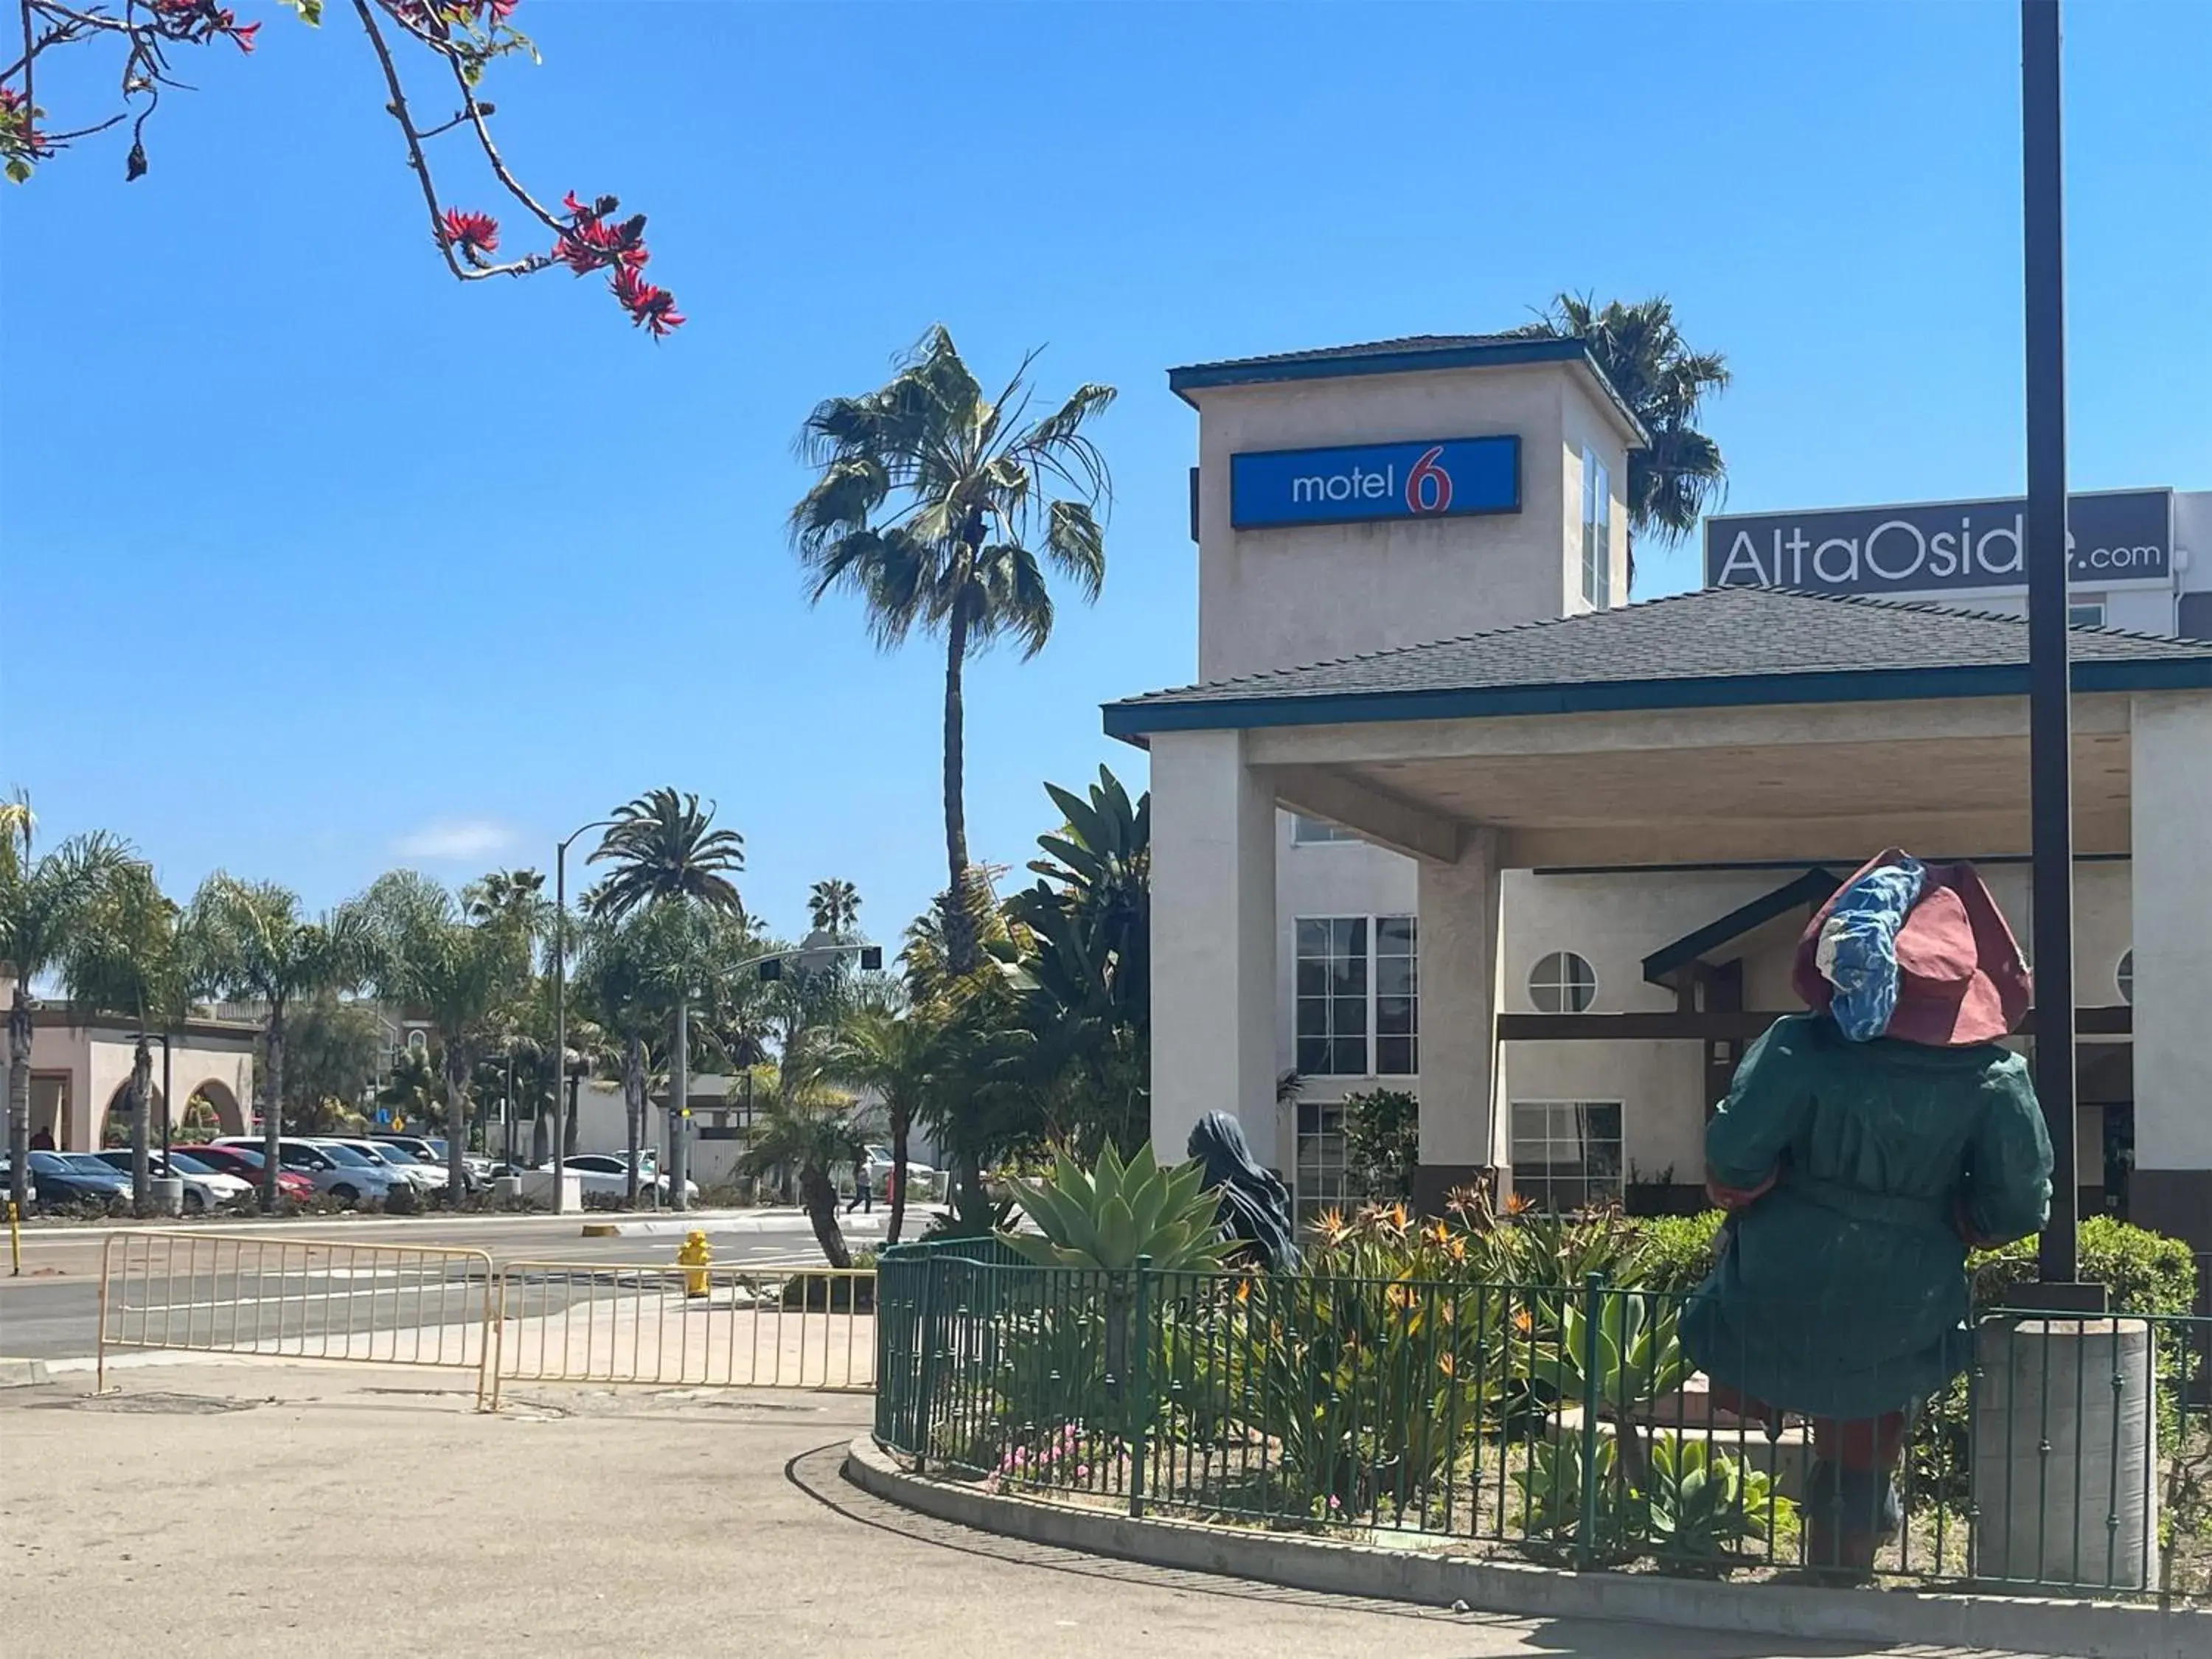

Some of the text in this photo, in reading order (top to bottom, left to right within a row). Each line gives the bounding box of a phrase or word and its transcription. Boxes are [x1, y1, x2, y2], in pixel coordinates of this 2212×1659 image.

[1293, 445, 1453, 513] motel 6
[1717, 514, 2161, 588] AltaOsid.com
